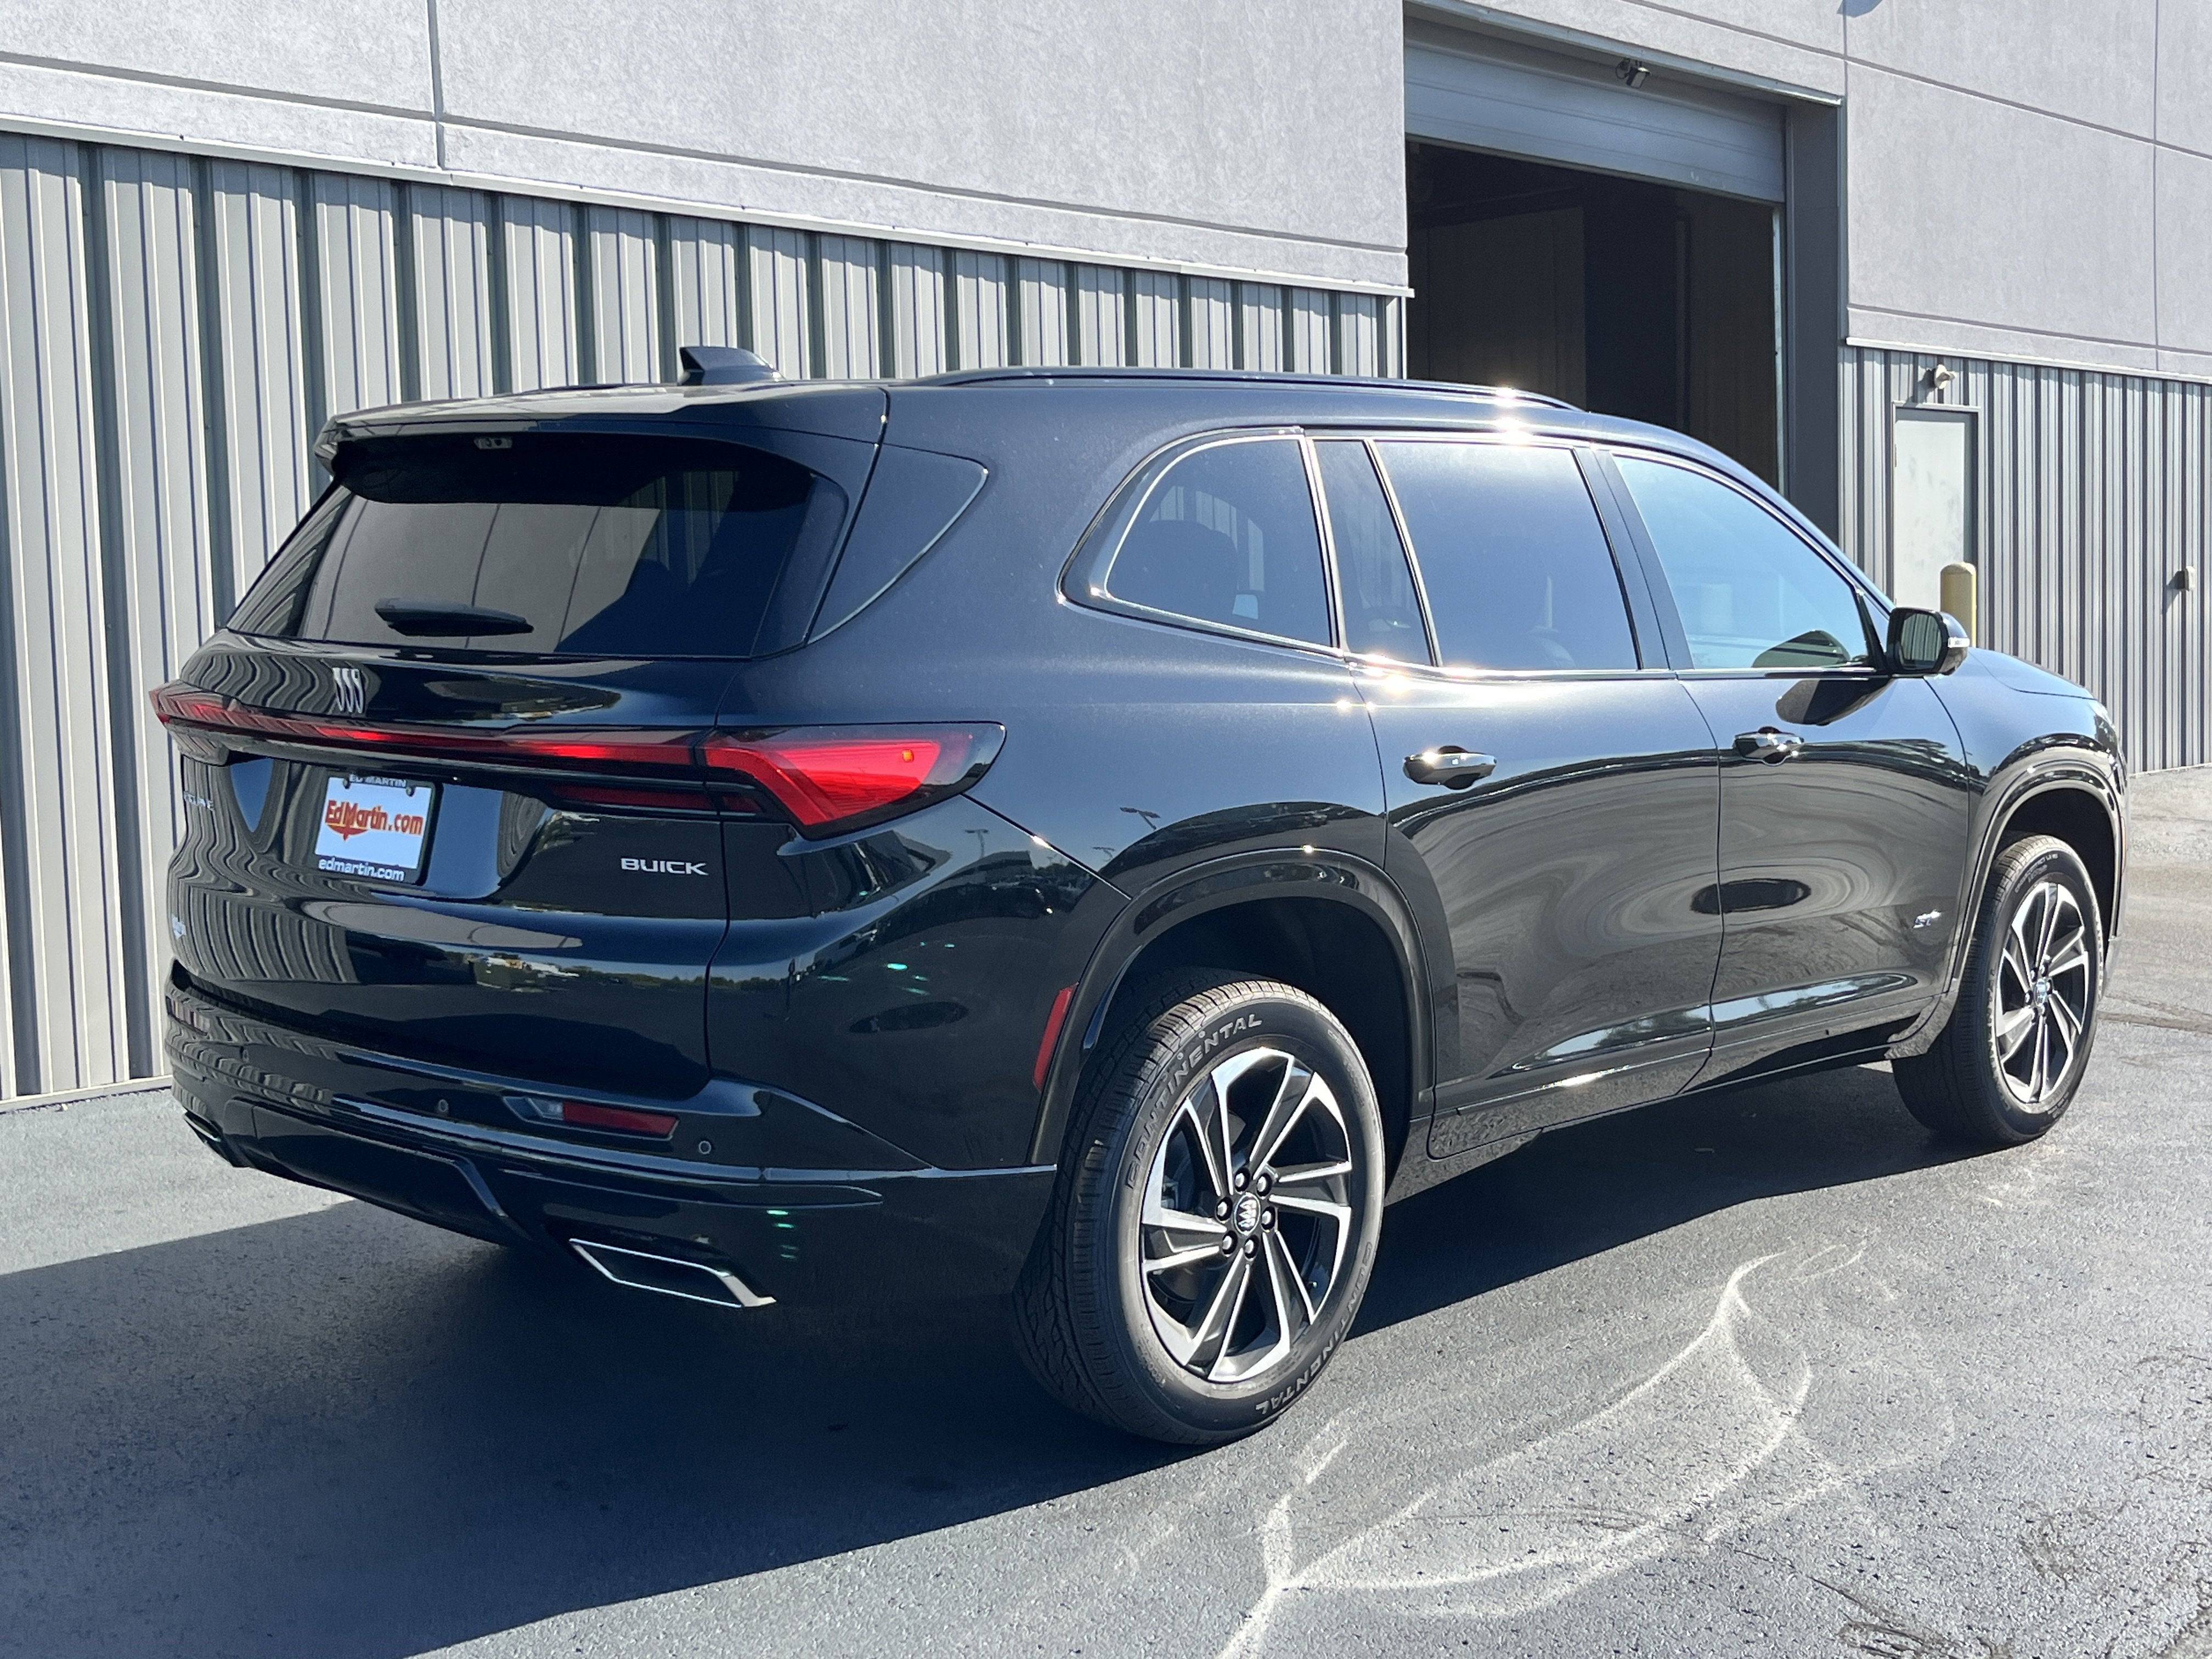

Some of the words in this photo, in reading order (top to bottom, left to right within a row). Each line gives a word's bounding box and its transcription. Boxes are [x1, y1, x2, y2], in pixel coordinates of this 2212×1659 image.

[365, 776, 407, 788] MARTIN
[325, 799, 424, 836] EdMartin.com
[318, 857, 405, 882] edmartin.com
[620, 858, 709, 876] BUICK
[1126, 1014, 1262, 1189] CONTINENTAL
